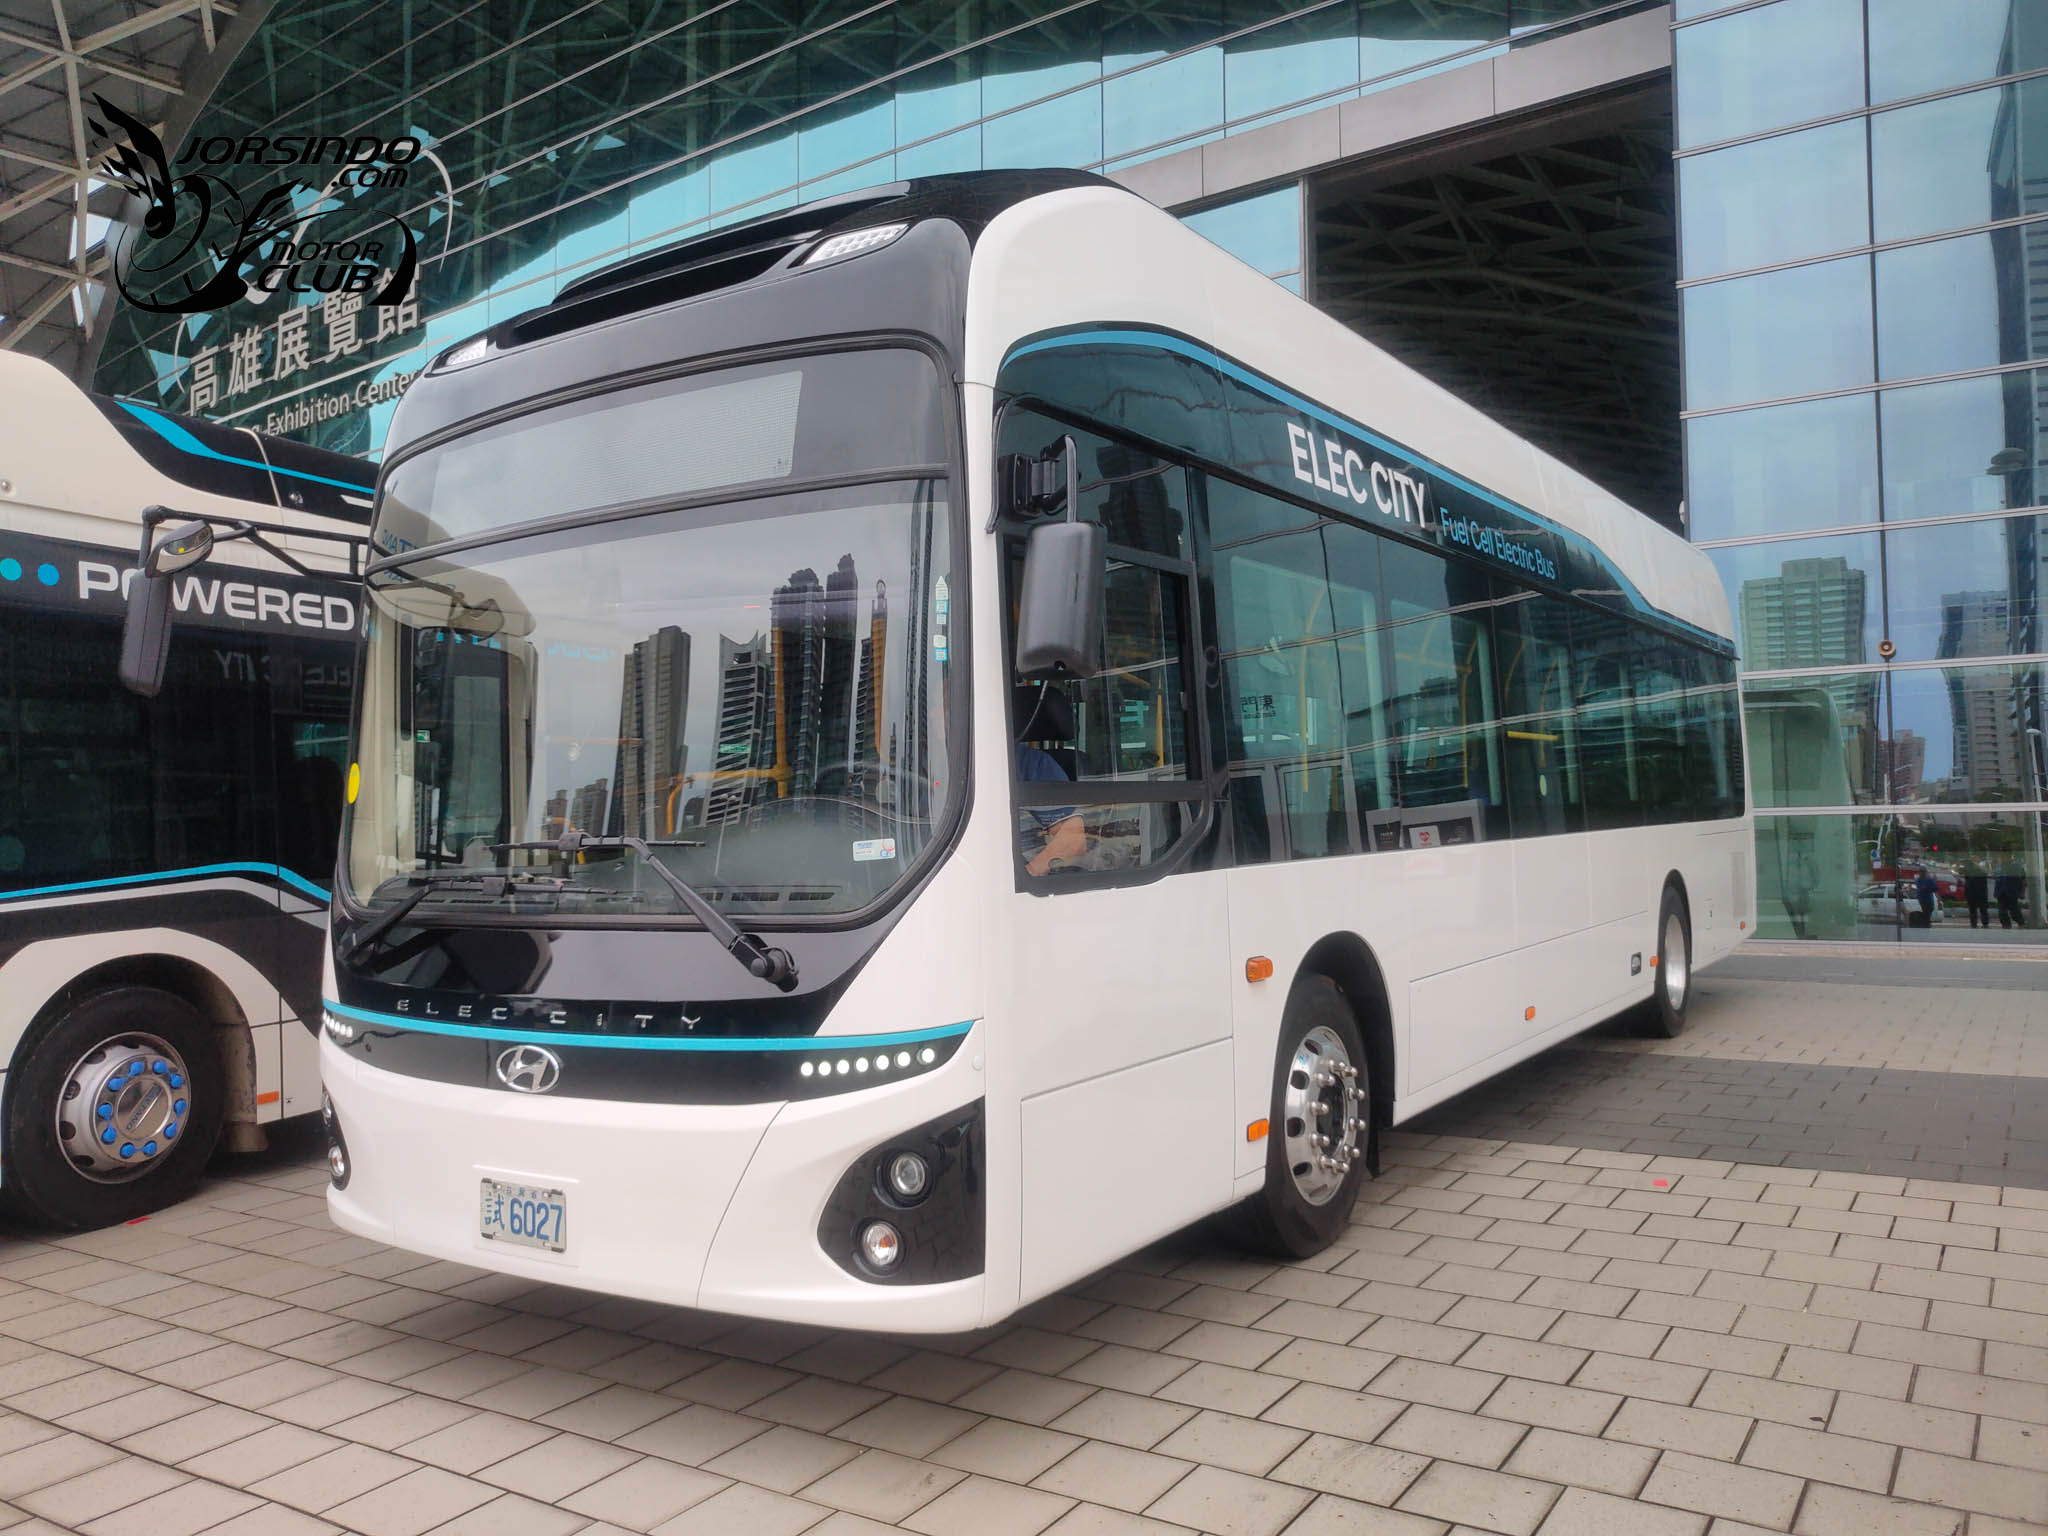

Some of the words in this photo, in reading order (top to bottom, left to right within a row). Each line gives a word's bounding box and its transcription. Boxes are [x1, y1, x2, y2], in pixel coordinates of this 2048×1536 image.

[267, 393, 350, 436] Exhibition
[1286, 421, 1368, 504] ELEC
[1370, 461, 1426, 529] CITY
[1440, 507, 1470, 545] Fuel
[1470, 521, 1495, 556] Cell
[1495, 530, 1536, 572] Electric
[1535, 548, 1555, 580] Bus
[78, 560, 354, 632] PWERED
[396, 999, 508, 1021] ELEC
[548, 1010, 702, 1030] CITY
[510, 1197, 563, 1243] 6027
